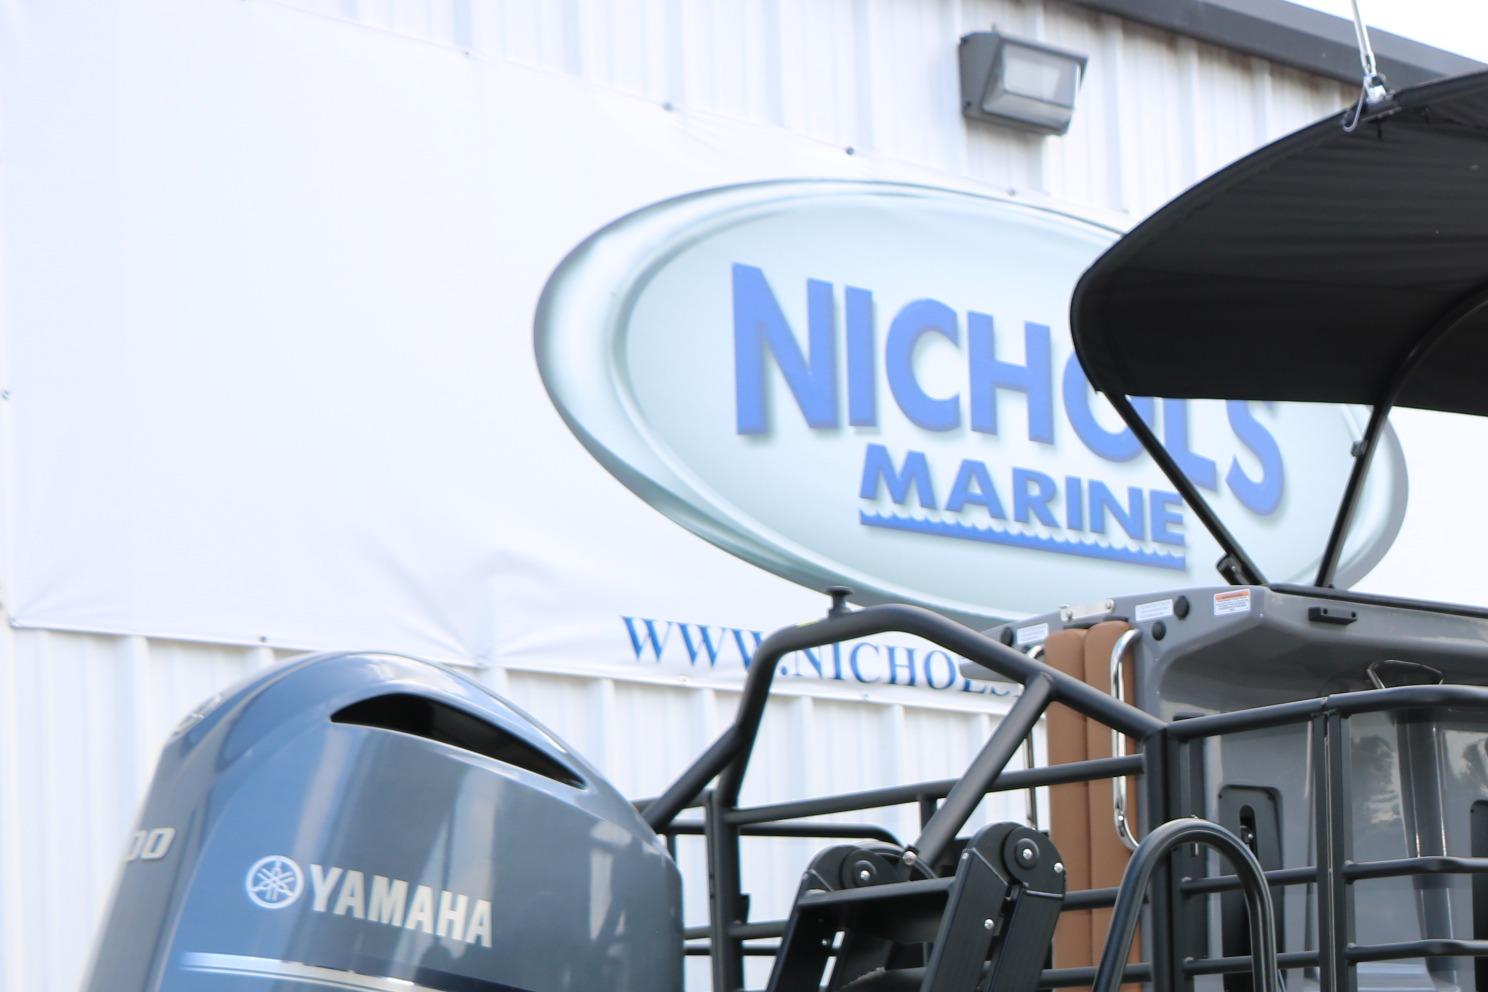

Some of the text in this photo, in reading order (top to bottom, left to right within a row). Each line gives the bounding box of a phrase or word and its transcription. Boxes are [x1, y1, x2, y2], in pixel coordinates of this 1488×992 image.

[731, 262, 1284, 517] NICHOLS
[860, 443, 1185, 546] MARINE
[311, 864, 492, 947] YAMAHA
